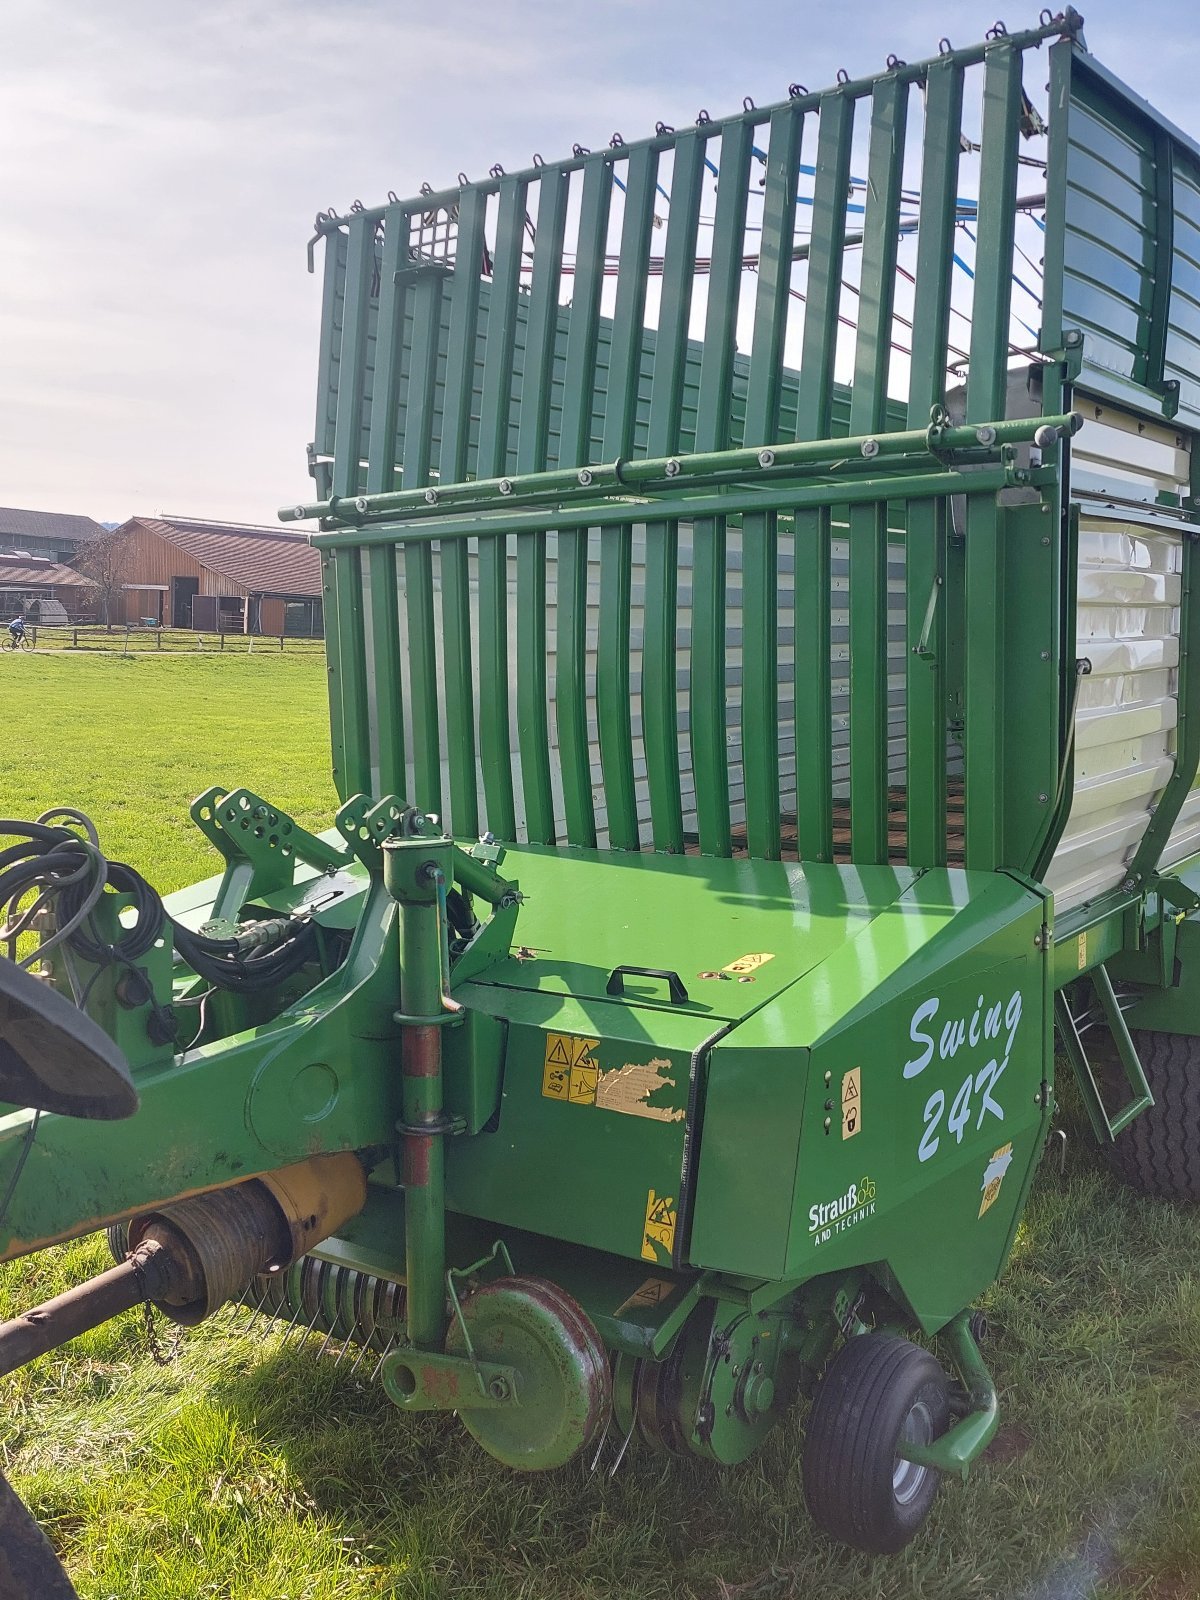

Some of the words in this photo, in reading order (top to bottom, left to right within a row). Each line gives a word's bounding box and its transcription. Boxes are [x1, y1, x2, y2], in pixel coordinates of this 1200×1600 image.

[903, 990, 1022, 1079] Swing
[918, 1056, 1009, 1162] 24K
[808, 1184, 857, 1231] Strauß
[835, 1202, 875, 1234] TECHNIK
